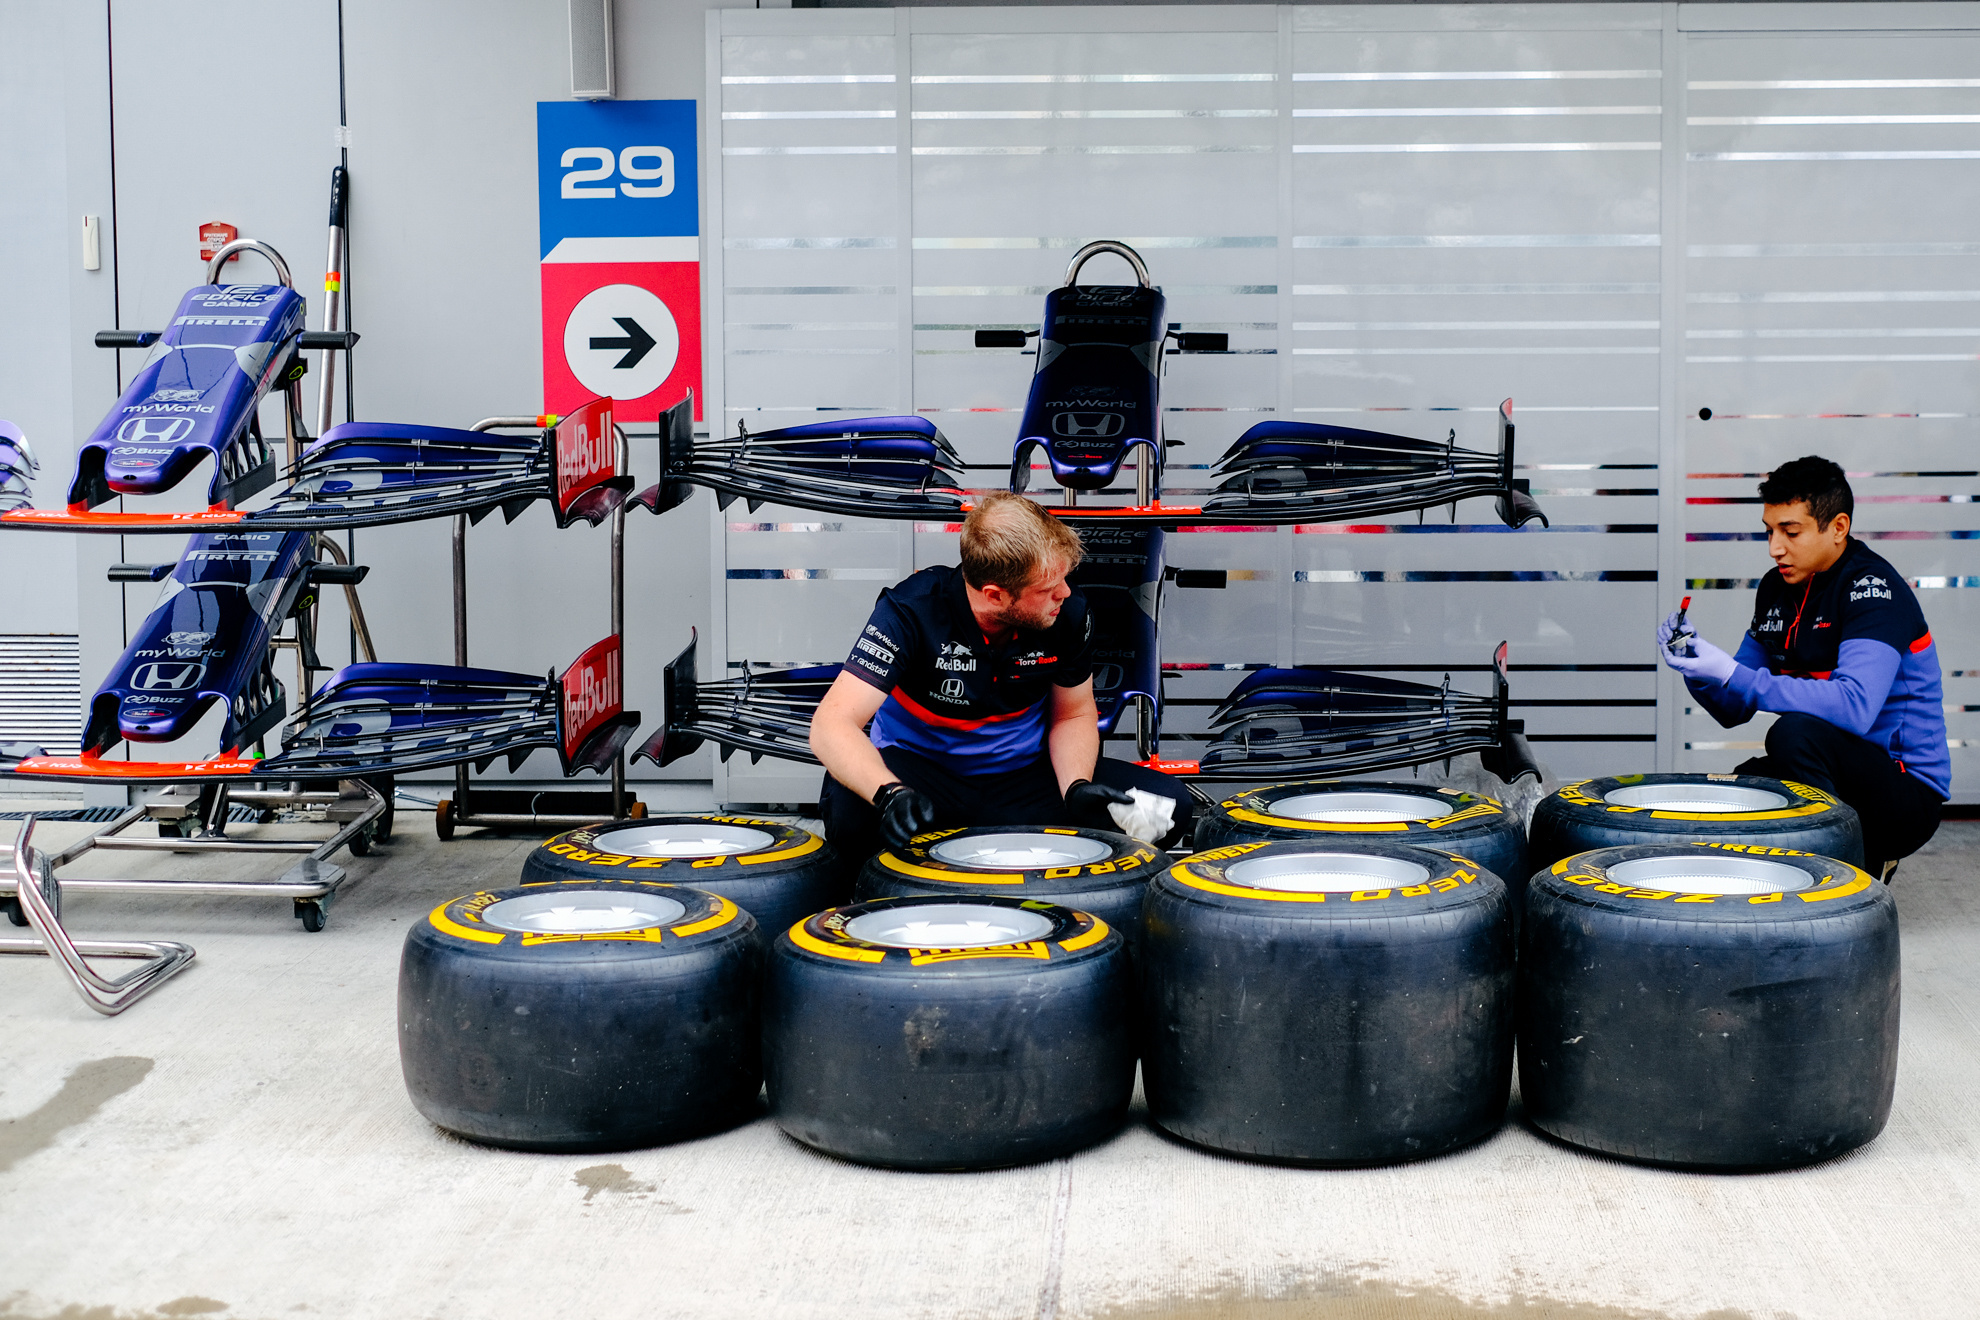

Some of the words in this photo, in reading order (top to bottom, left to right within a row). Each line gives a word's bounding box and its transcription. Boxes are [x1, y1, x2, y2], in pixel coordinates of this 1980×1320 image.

[560, 145, 675, 199] 29
[191, 293, 281, 301] EDIFICE
[173, 315, 270, 327] PIRELLI
[1055, 315, 1150, 327] PIRELLI
[122, 403, 216, 414] myWorld
[1045, 399, 1137, 409] myWorld
[136, 447, 175, 455] Buzz
[1080, 441, 1117, 449] Buzz
[1081, 530, 1149, 538] DIFICE
[185, 549, 280, 562] PIRELLI
[1081, 553, 1149, 565] RELLI
[1849, 587, 1871, 602] Red
[1871, 587, 1892, 601] Bull
[874, 630, 900, 653] myWorld
[134, 647, 226, 658] myWorld
[856, 637, 896, 665] PIRELLI
[856, 657, 889, 678] randstad
[935, 656, 953, 671] Red
[953, 658, 977, 672] Bull
[149, 696, 186, 704] Buzz
[928, 690, 971, 706] HONDA
[1780, 779, 1838, 806] PIRELLI
[548, 843, 672, 868] ZERO
[1173, 841, 1272, 864] PIRELLI
[692, 856, 728, 869] P
[1044, 848, 1156, 880] ZERO
[1350, 869, 1477, 902] ZERO
[1564, 874, 1724, 903] ZERO
[1748, 892, 1783, 904] P
